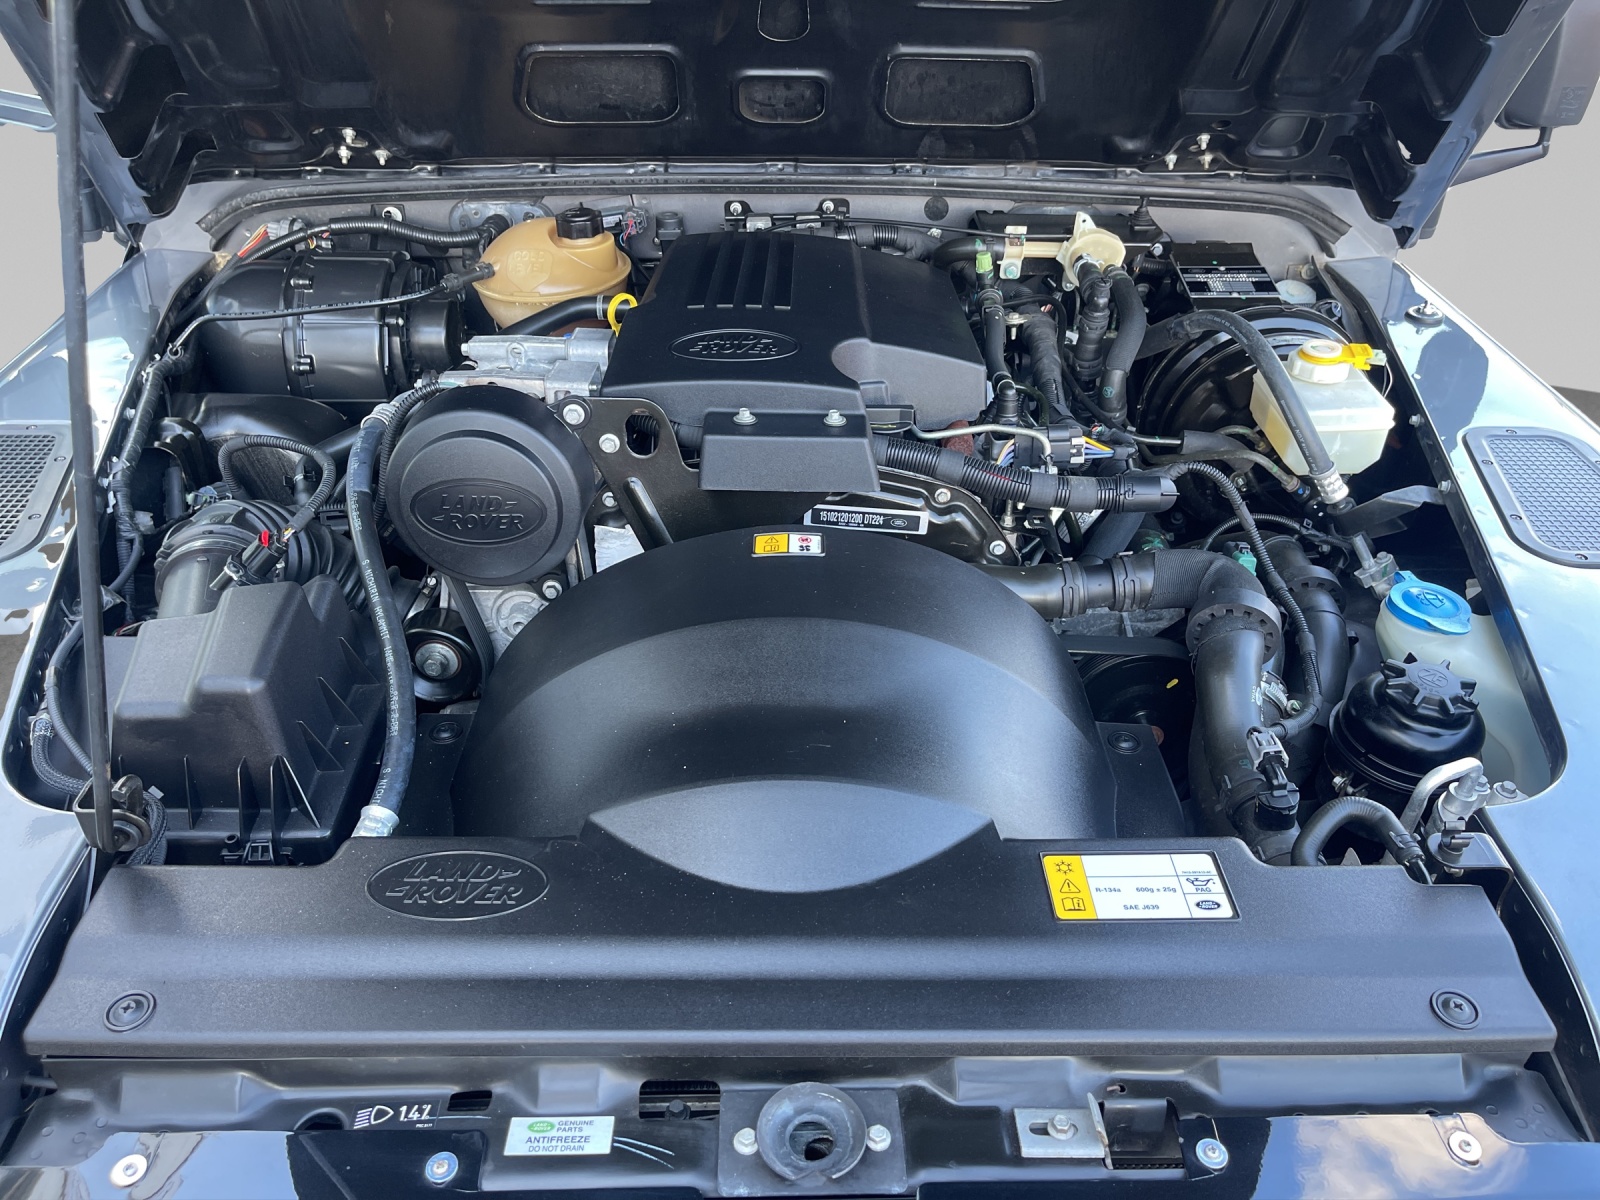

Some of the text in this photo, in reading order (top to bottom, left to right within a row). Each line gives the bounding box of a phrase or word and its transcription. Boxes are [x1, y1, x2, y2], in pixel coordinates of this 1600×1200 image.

[440, 493, 504, 512] LAND
[447, 513, 524, 530] ROVER
[819, 510, 863, 524] 151021201200
[403, 861, 501, 882] LAND
[403, 883, 524, 904] ROVER
[1135, 886, 1155, 894] 600g
[1162, 886, 1177, 894] 25g
[525, 1135, 591, 1144] ANTIFREEZE
[528, 1145, 540, 1153] DO
[559, 1144, 585, 1152] DRAIN
